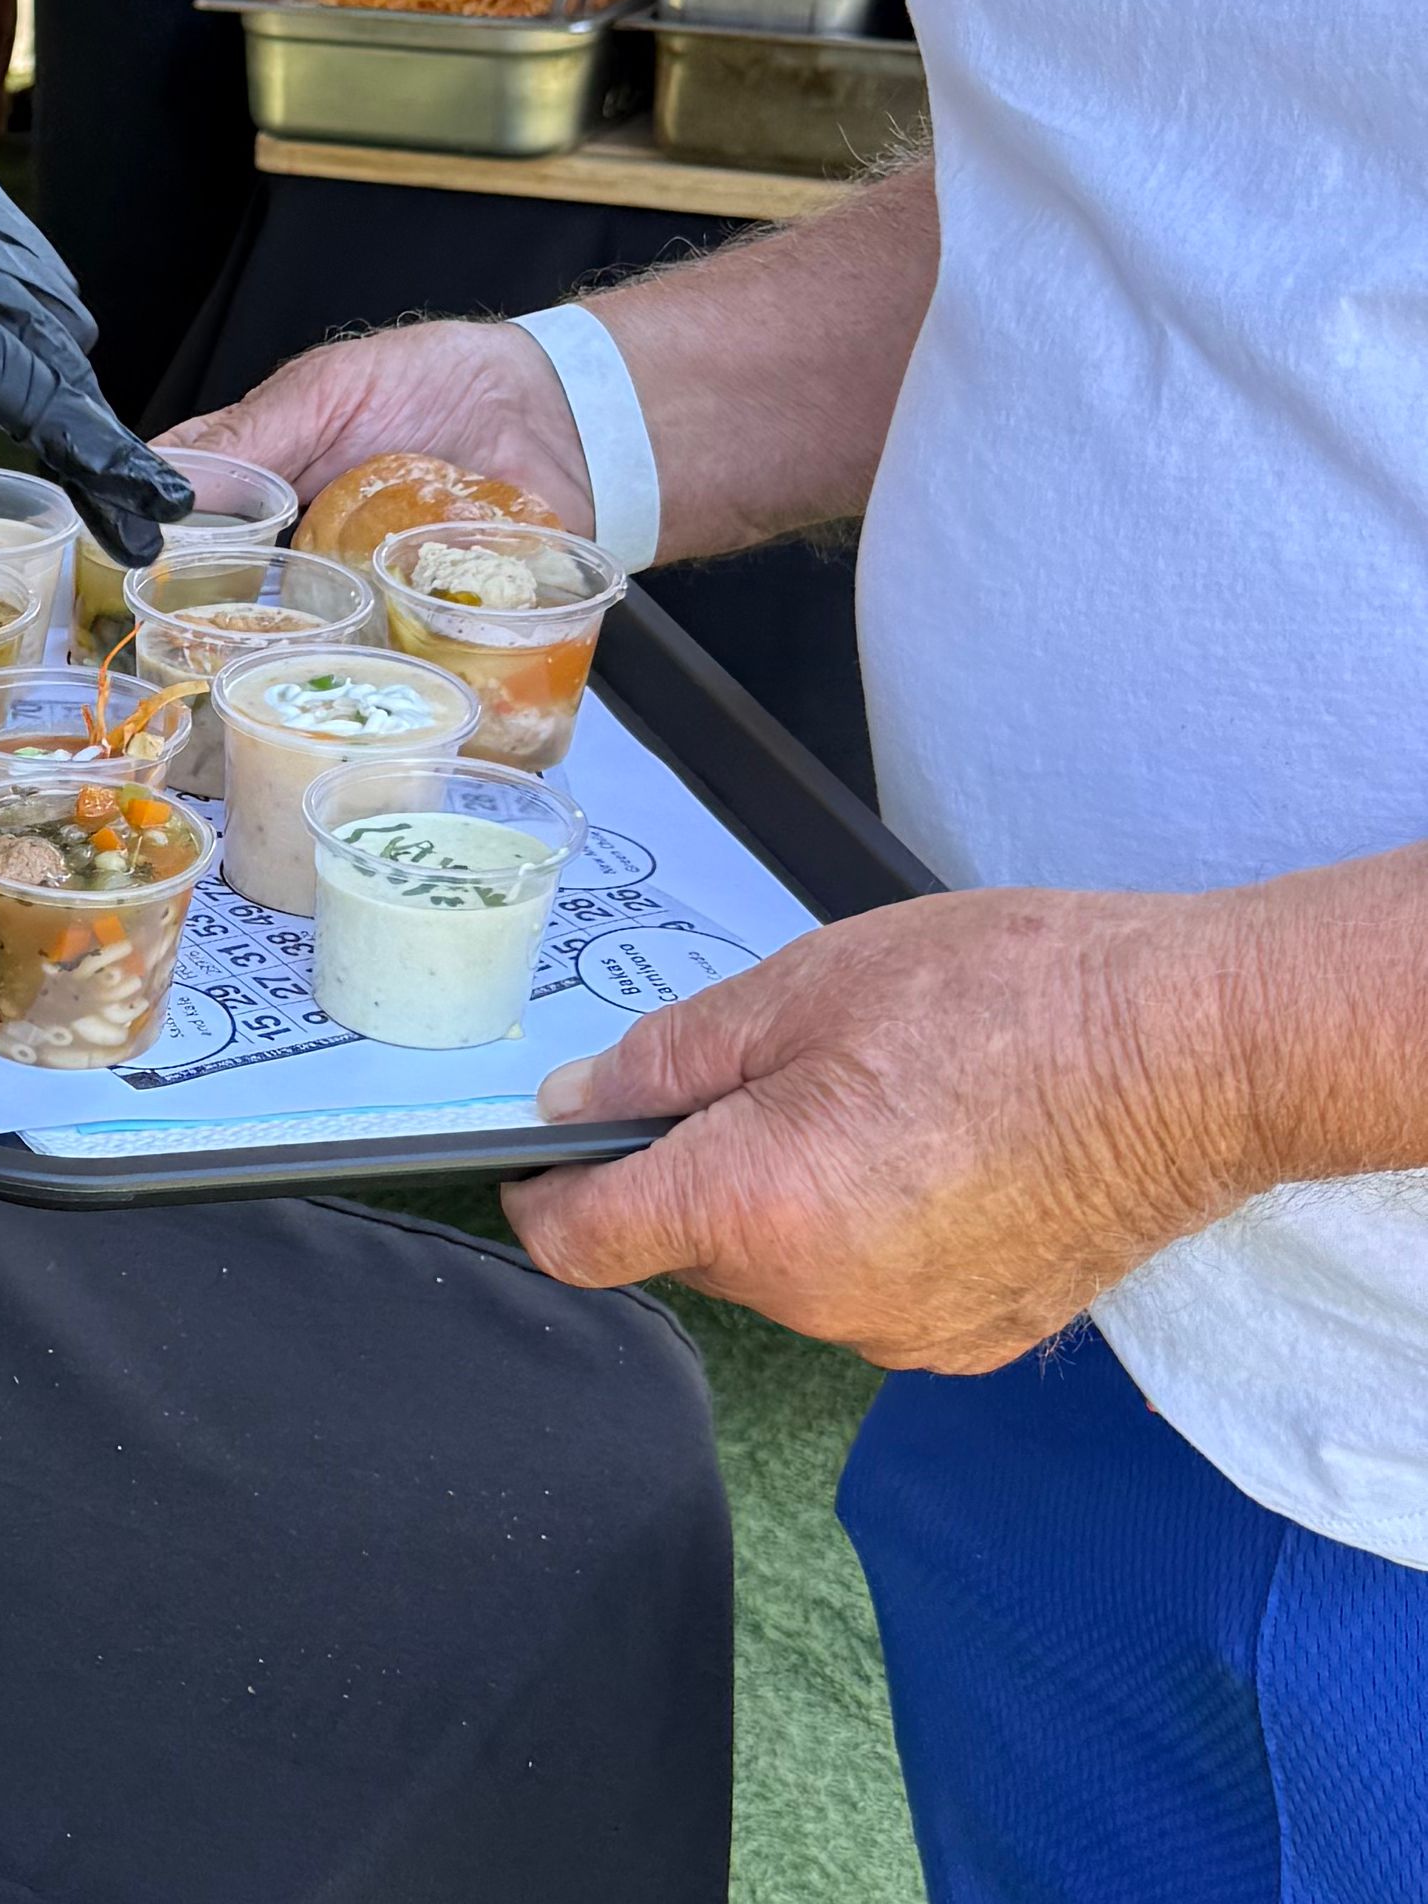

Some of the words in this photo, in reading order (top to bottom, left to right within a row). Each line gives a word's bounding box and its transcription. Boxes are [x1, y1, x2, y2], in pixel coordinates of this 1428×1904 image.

[557, 898, 615, 922] 28
[606, 889, 664, 913] 26
[228, 904, 275, 927] 49
[216, 943, 267, 968] 31
[265, 931, 315, 957] 38
[600, 957, 643, 997] Bakas
[619, 943, 680, 1004] Carnivoro
[206, 983, 260, 1011] 29
[252, 975, 310, 1000] 27
[242, 1014, 293, 1042] 15
